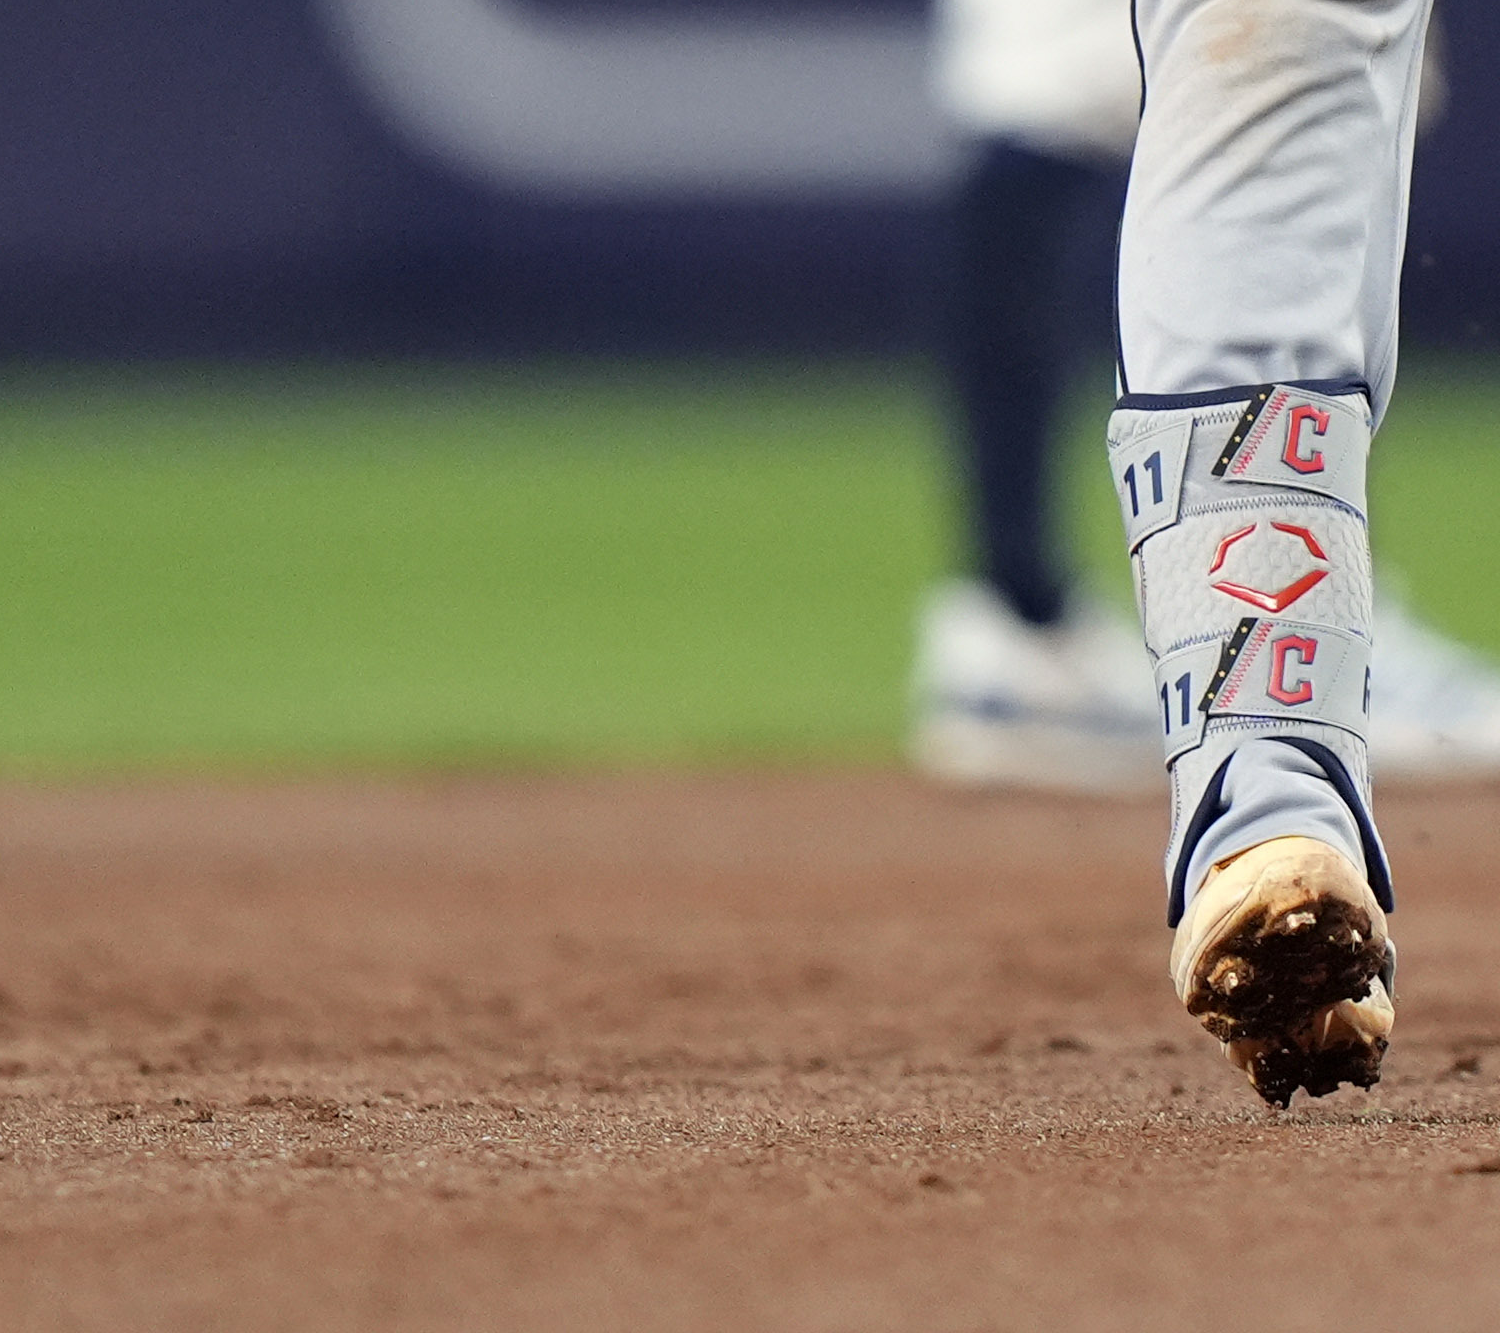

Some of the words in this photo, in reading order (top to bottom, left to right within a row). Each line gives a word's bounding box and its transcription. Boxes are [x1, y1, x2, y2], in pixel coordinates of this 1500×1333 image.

[1281, 403, 1331, 475] C
[1123, 450, 1163, 518] 11
[1160, 671, 1192, 736] 11
[1266, 633, 1319, 707] C
